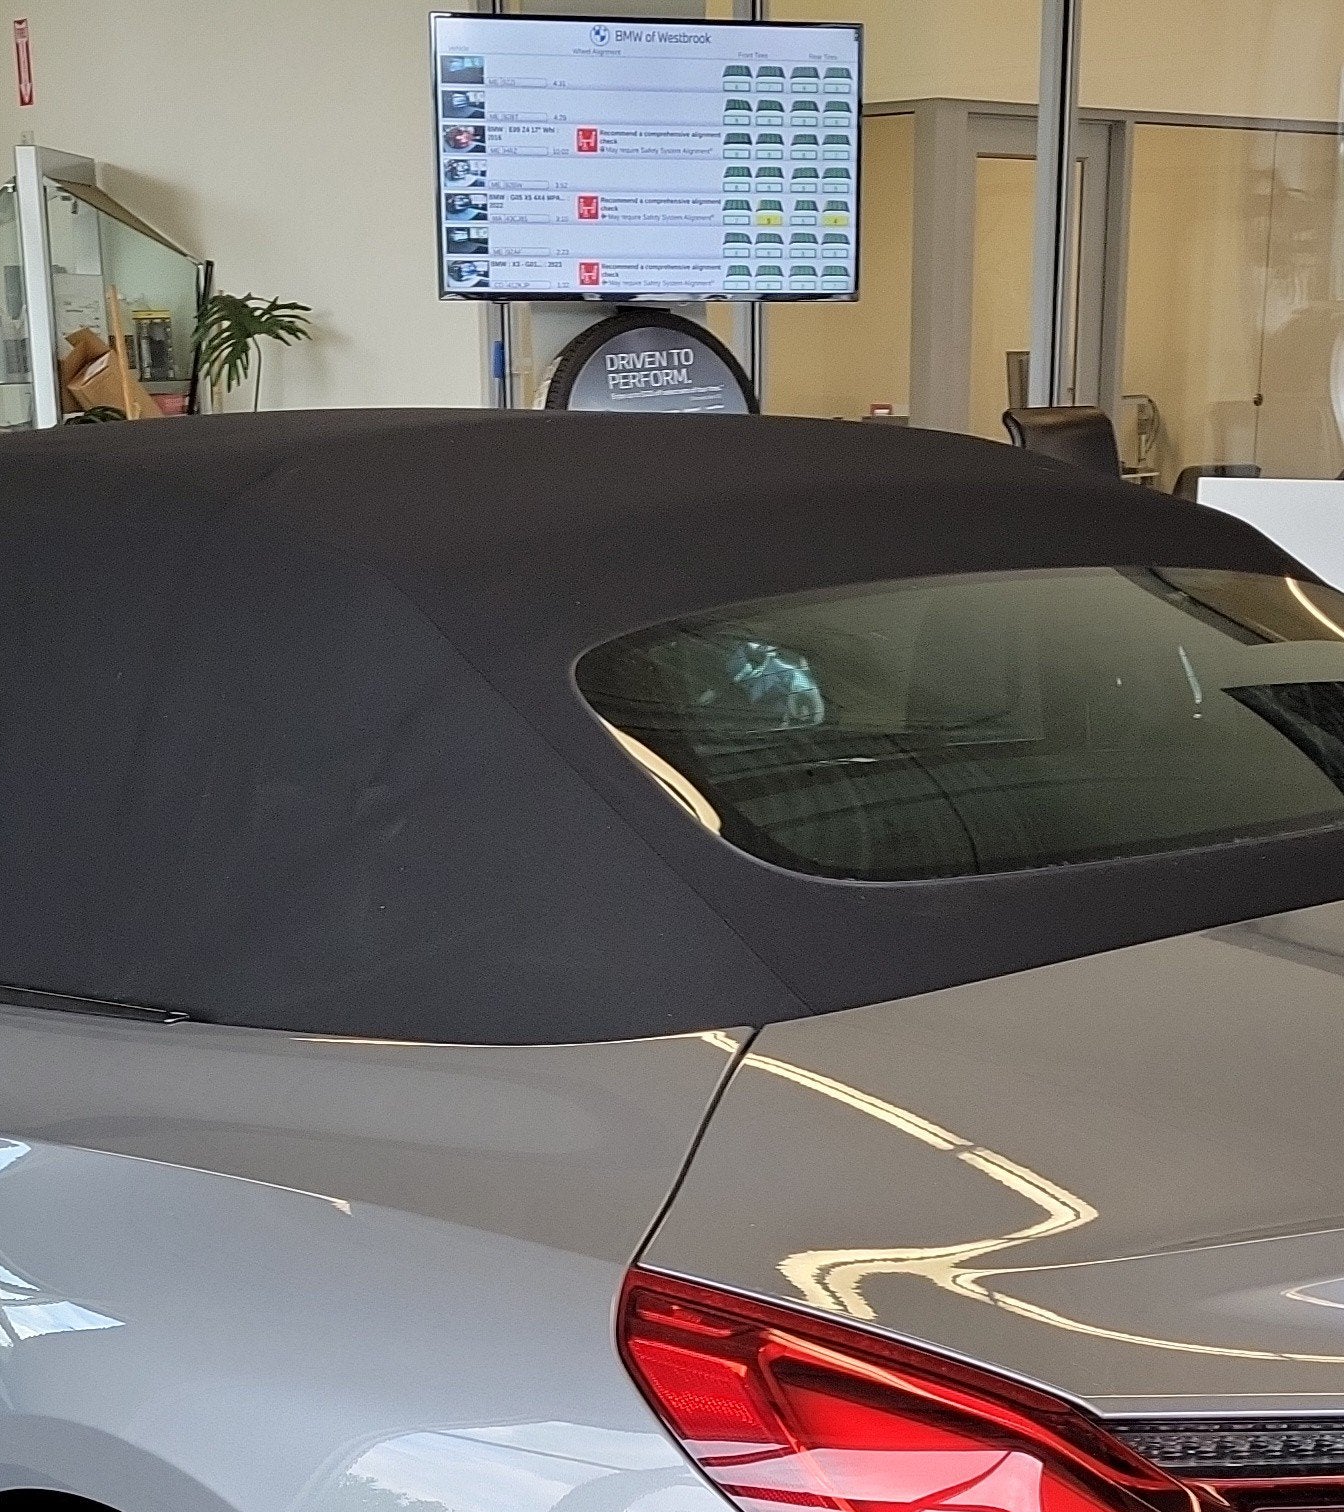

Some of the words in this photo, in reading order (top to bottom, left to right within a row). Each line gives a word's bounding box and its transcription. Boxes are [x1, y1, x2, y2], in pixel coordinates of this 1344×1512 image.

[615, 30, 643, 42] BMW
[645, 31, 656, 43] of
[657, 31, 713, 44] Westbrook
[605, 351, 668, 371] DRIVEN
[668, 349, 694, 367] TO
[608, 368, 693, 389] PERFORM.
